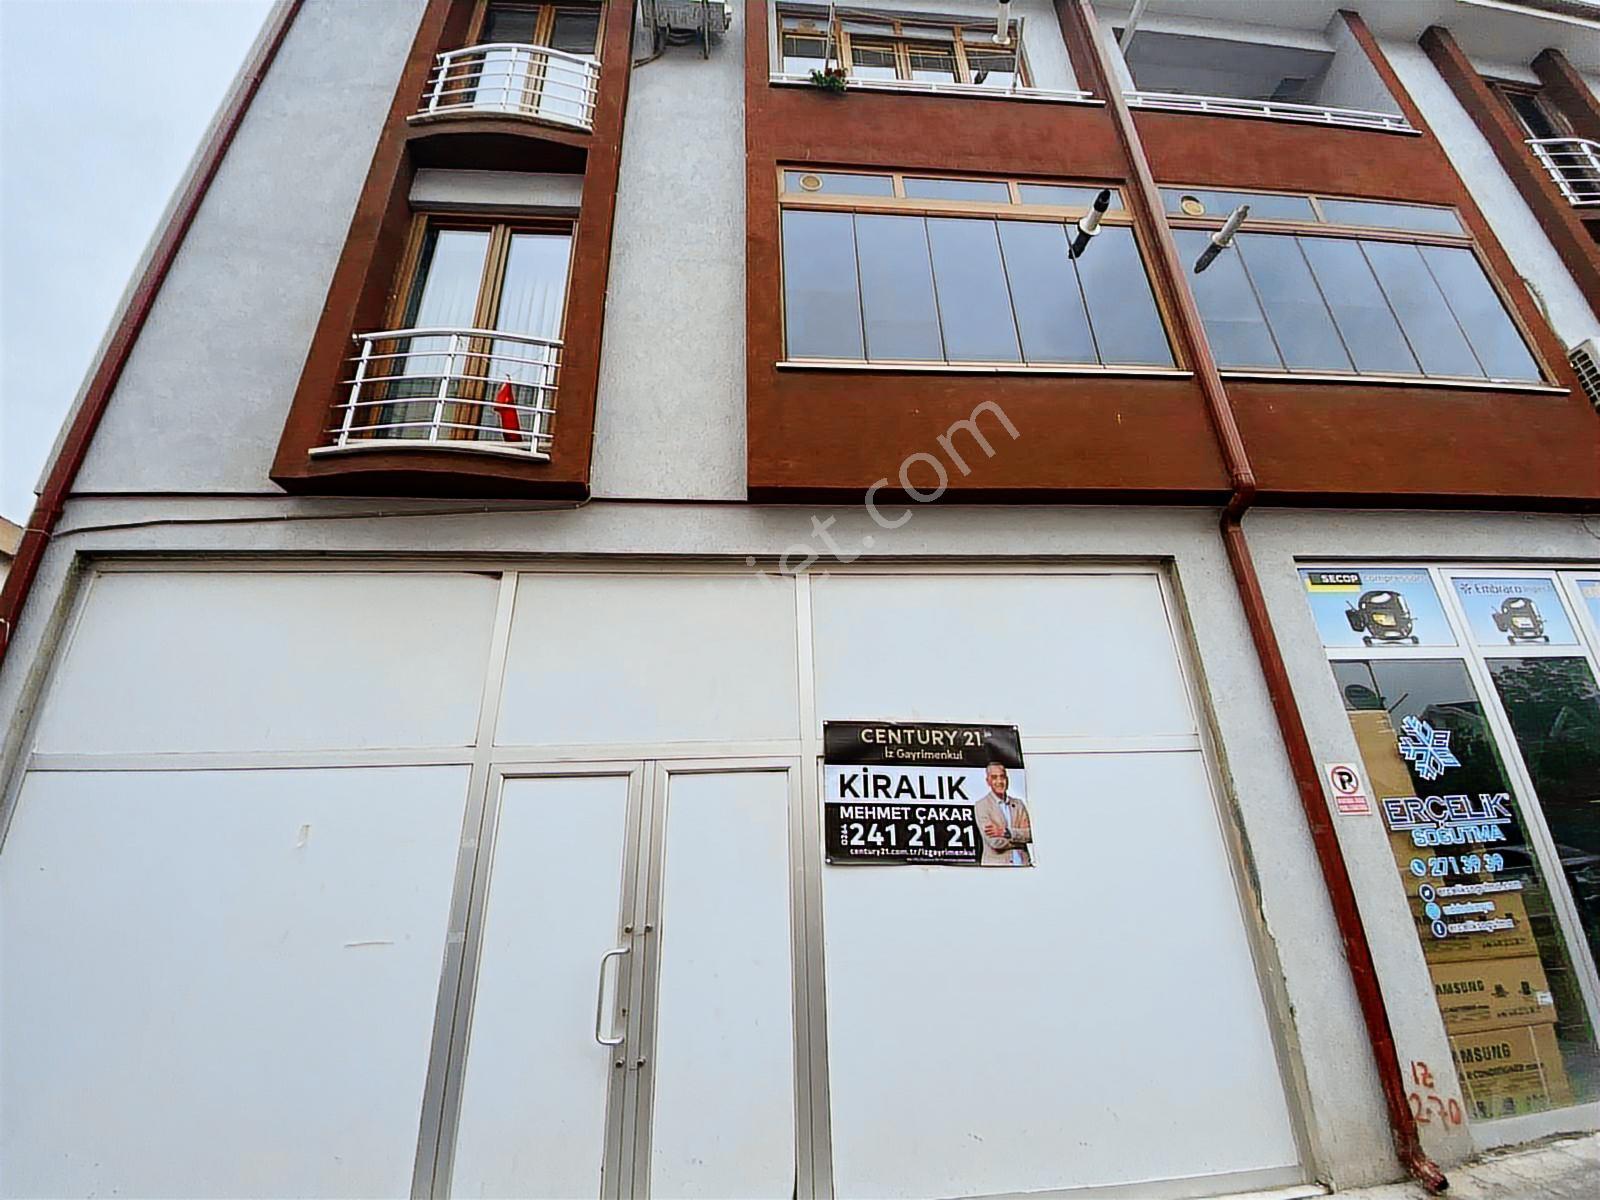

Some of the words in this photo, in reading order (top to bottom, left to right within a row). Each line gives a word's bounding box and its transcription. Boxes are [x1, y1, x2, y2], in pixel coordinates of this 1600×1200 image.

[1320, 574, 1359, 584] SECOP
[861, 728, 958, 746] CENTURY
[963, 731, 982, 746] 21
[896, 748, 963, 761] Gayrimenkul
[839, 767, 969, 800] KİRALIK
[840, 806, 911, 820] MEHMET
[915, 807, 973, 824] ÇAKAR
[849, 823, 896, 846] 241
[907, 823, 936, 847] 21
[946, 824, 976, 847] 21
[1428, 856, 1460, 876] 271
[1435, 980, 1485, 994] AMSUNG
[1452, 1043, 1512, 1064] MSUNG
